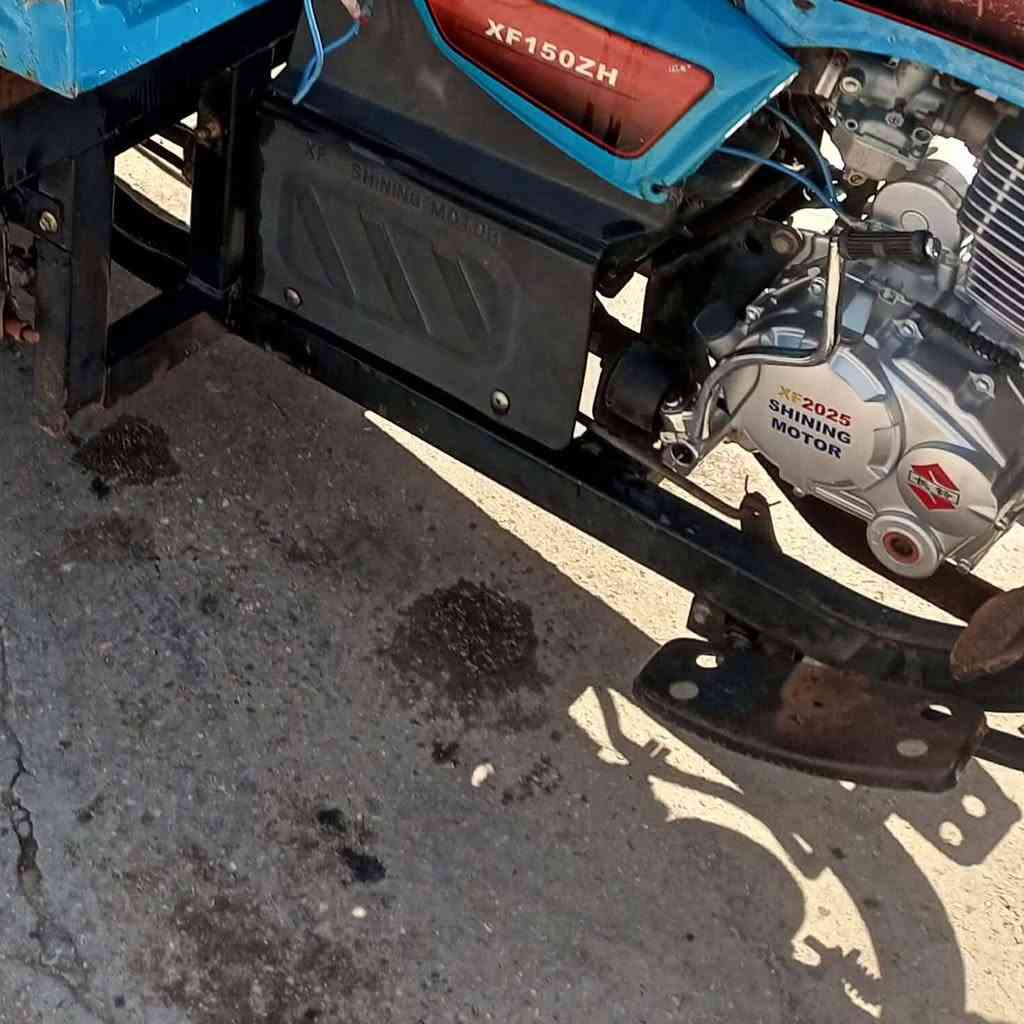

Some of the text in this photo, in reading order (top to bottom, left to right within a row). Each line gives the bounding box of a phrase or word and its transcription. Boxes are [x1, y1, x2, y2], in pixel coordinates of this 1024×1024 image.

[485, 18, 619, 87] XF150ZH
[351, 162, 422, 209] SHINING
[768, 398, 852, 445] SHINING
[777, 385, 852, 428] XF2025
[771, 417, 843, 460] MOTOR
